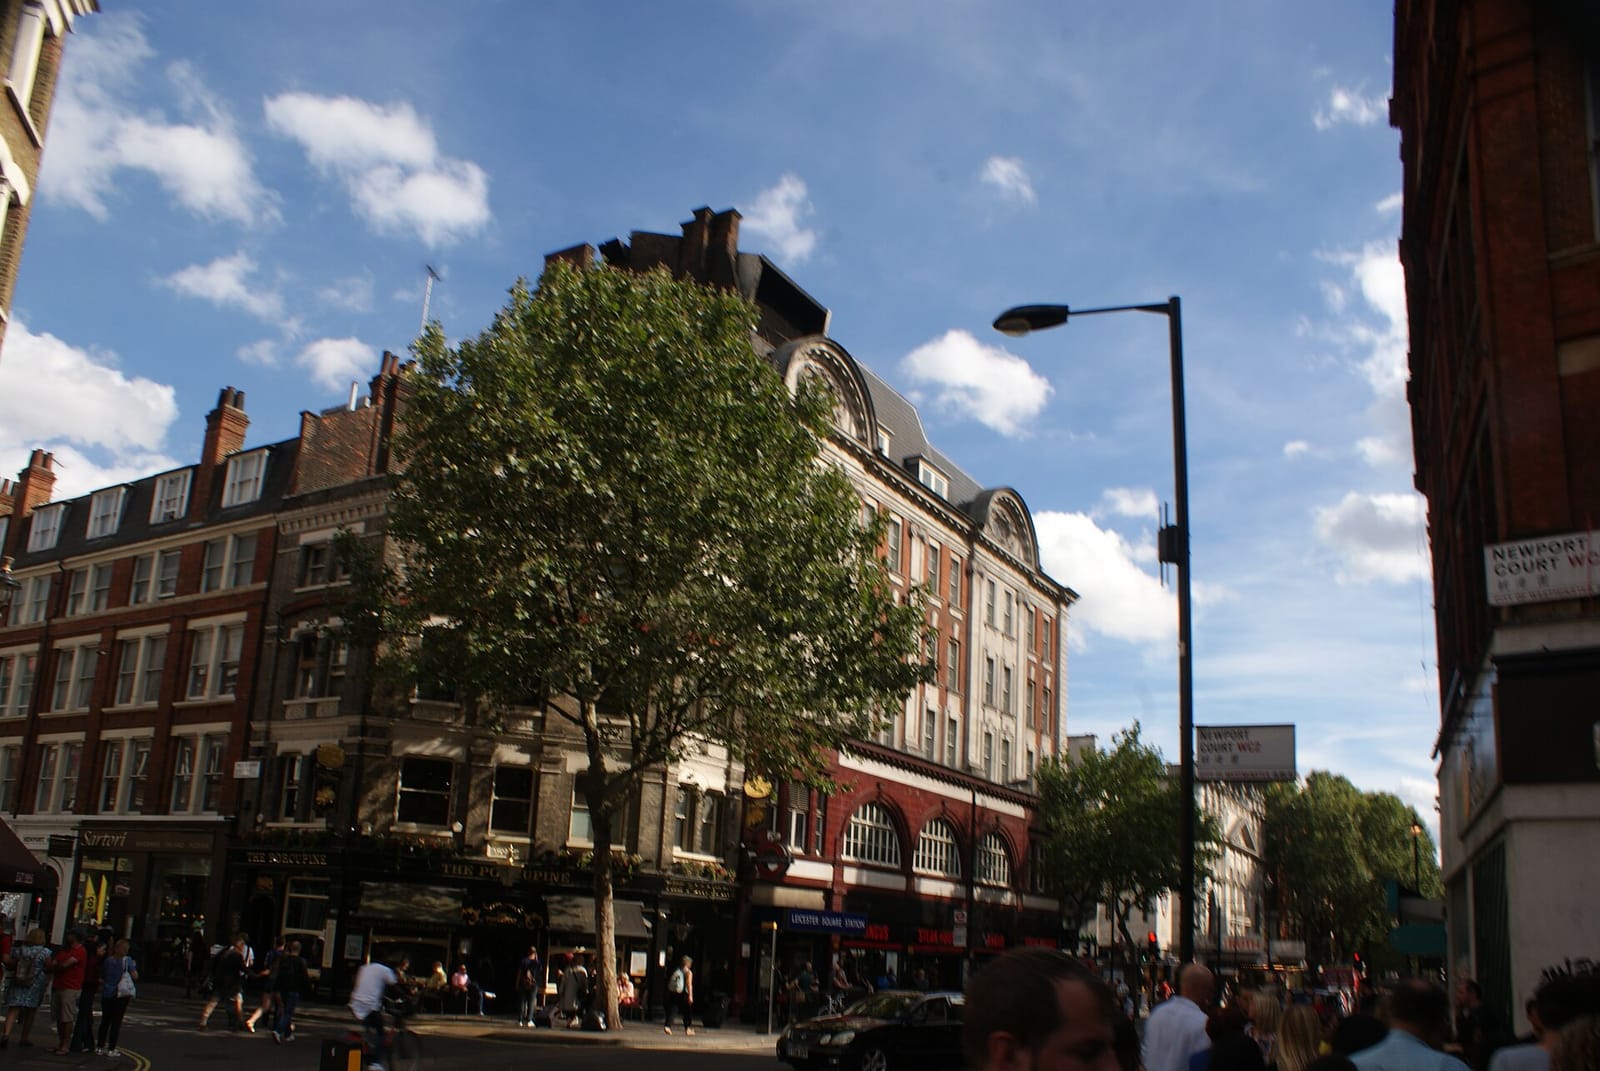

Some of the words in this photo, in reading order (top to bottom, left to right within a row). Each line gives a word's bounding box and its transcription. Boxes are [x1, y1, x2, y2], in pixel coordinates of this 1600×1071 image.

[1492, 537, 1587, 561] NEWPORT
[1494, 556, 1560, 577] COURT
[1200, 728, 1249, 740] NEWPORT
[1200, 741, 1233, 753] COURT
[80, 830, 128, 848] Sartori
[247, 850, 266, 863] THE
[440, 863, 473, 876] THE
[479, 866, 571, 883] POUPINE
[791, 912, 819, 926] LEICESTER
[821, 915, 843, 928] SQUARE
[844, 917, 866, 929] STATION
